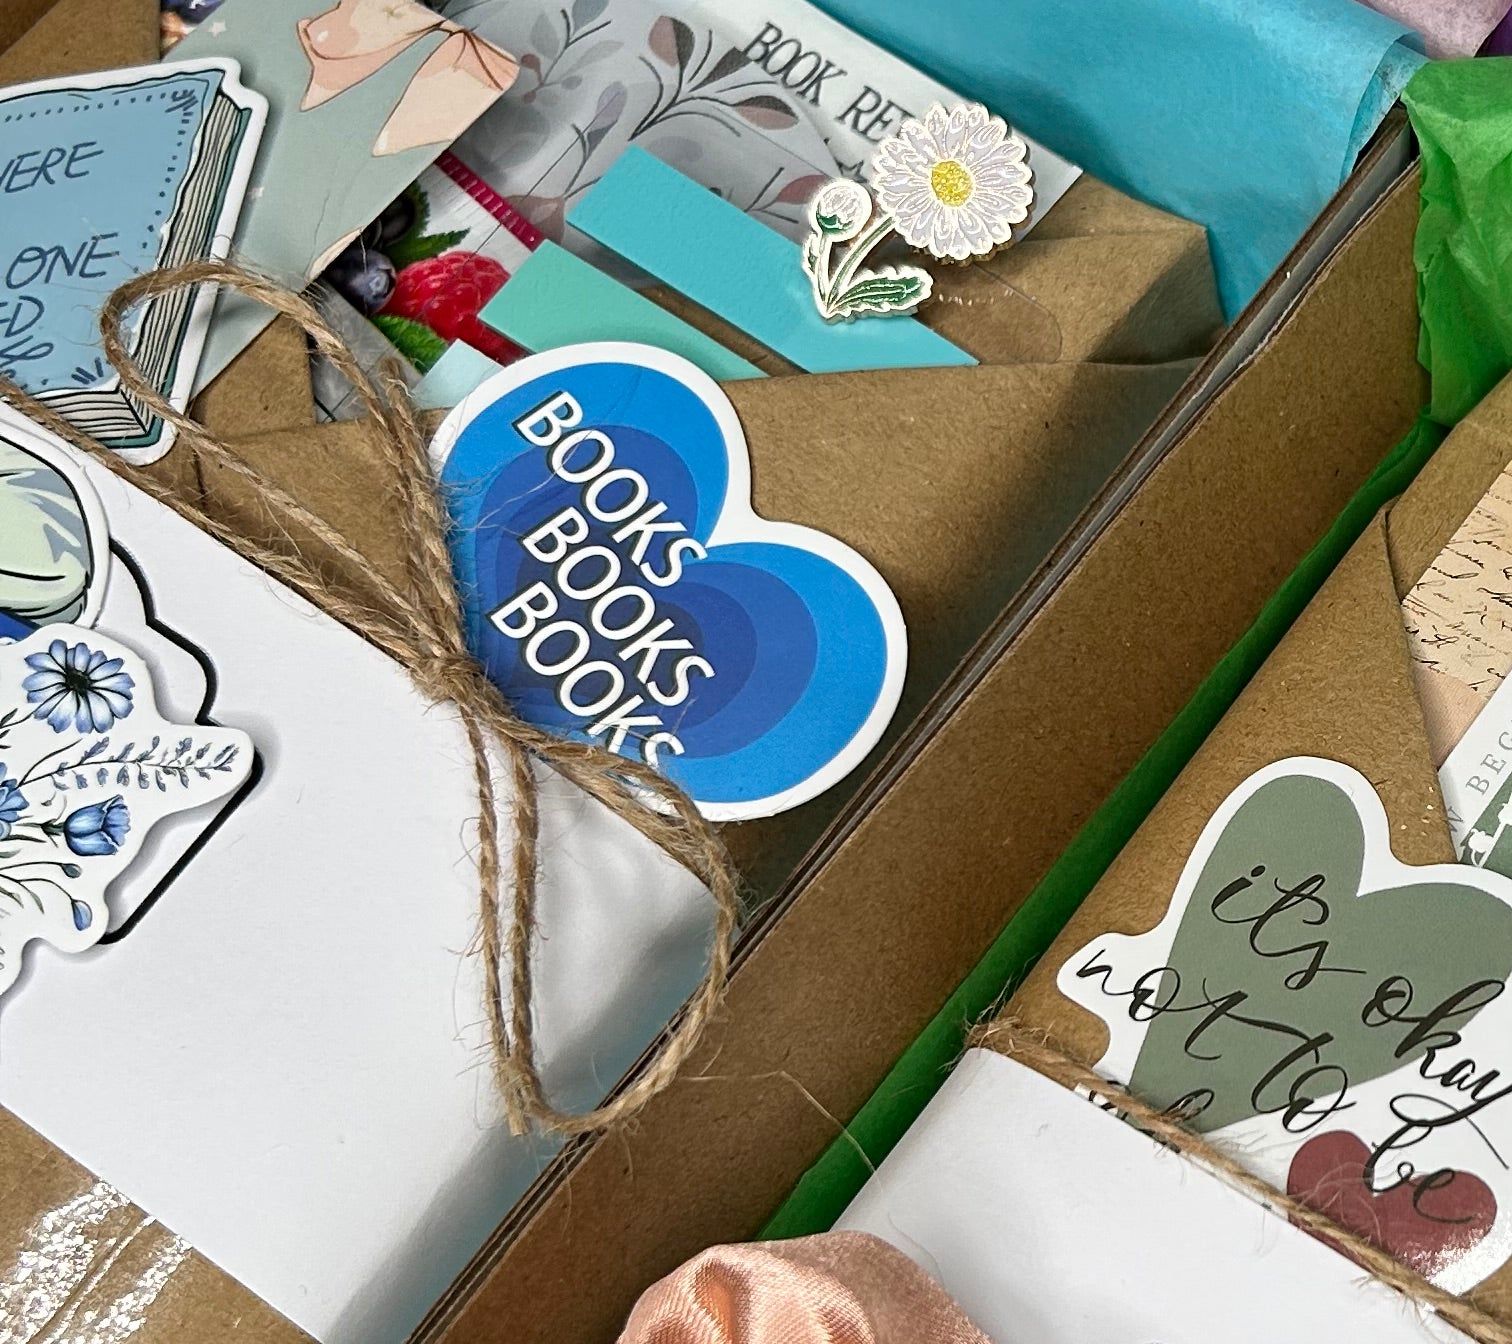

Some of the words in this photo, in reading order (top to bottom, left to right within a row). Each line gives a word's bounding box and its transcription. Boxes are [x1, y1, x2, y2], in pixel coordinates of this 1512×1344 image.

[743, 21, 848, 107] BOOK
[0, 141, 105, 194] ERE
[6, 232, 120, 290] ONE
[513, 391, 709, 588] BOOKS
[520, 506, 716, 708] BOOKS
[487, 582, 686, 775] BOOKS
[1211, 865, 1367, 991] its
[1076, 949, 1262, 1060] not
